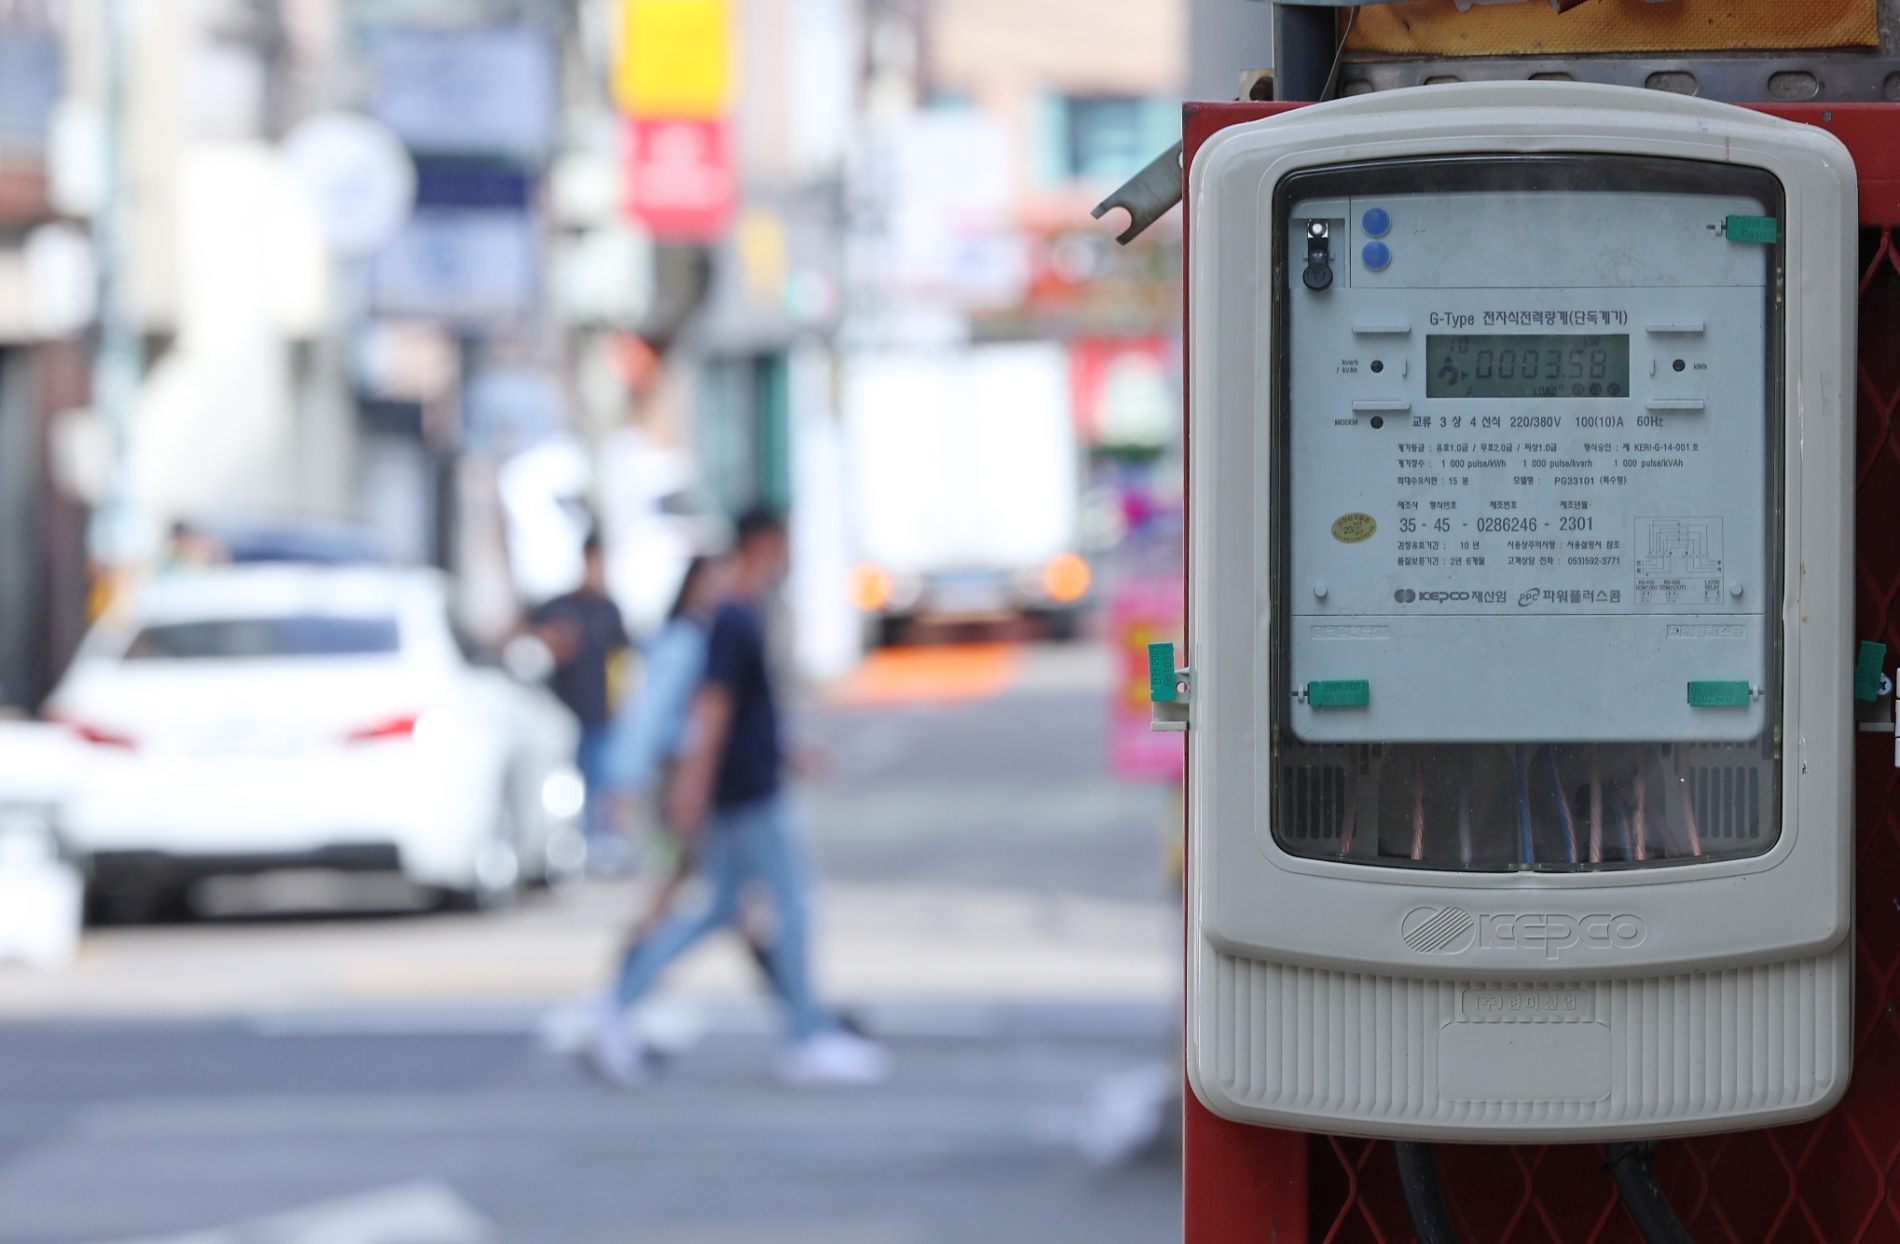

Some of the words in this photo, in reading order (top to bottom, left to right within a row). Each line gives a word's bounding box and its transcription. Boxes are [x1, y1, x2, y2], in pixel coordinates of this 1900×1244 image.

[1430, 312, 1475, 328] G-Type
[1483, 311, 1628, 326] 전자식전력량계(단독계기)
[1476, 350, 1608, 379] 0003.58
[1412, 416, 1431, 428] 교류
[1440, 416, 1447, 428] 3
[1452, 416, 1462, 428] 상
[1470, 416, 1477, 428] 4
[1482, 416, 1501, 428] 선식
[1510, 416, 1562, 428] 220/380V
[1575, 415, 1624, 428] 100(10)A
[1637, 415, 1664, 427] 60Hz
[1634, 443, 1690, 453] KERI-G-14-001
[1467, 459, 1507, 469] pulse/kWh
[1549, 459, 1593, 469] pulse/kvarh
[1641, 459, 1684, 468] pulse/kVAh
[1448, 477, 1458, 485] 15
[1554, 477, 1595, 485] PG33101
[1397, 501, 1419, 510] 제조사
[1490, 501, 1518, 510] 제조번호
[1399, 517, 1417, 533] 35
[1433, 517, 1451, 533] 45
[1476, 517, 1538, 532] 0286246
[1559, 516, 1593, 531] 2301
[1460, 541, 1470, 550] 10
[1567, 556, 1620, 566] 053)592-3771
[1542, 589, 1621, 603] 파워플러스콤
[1151, 646, 1160, 665] 2021
[1344, 682, 1365, 692] 2021
[1475, 993, 1577, 1011] (주)한미산업
